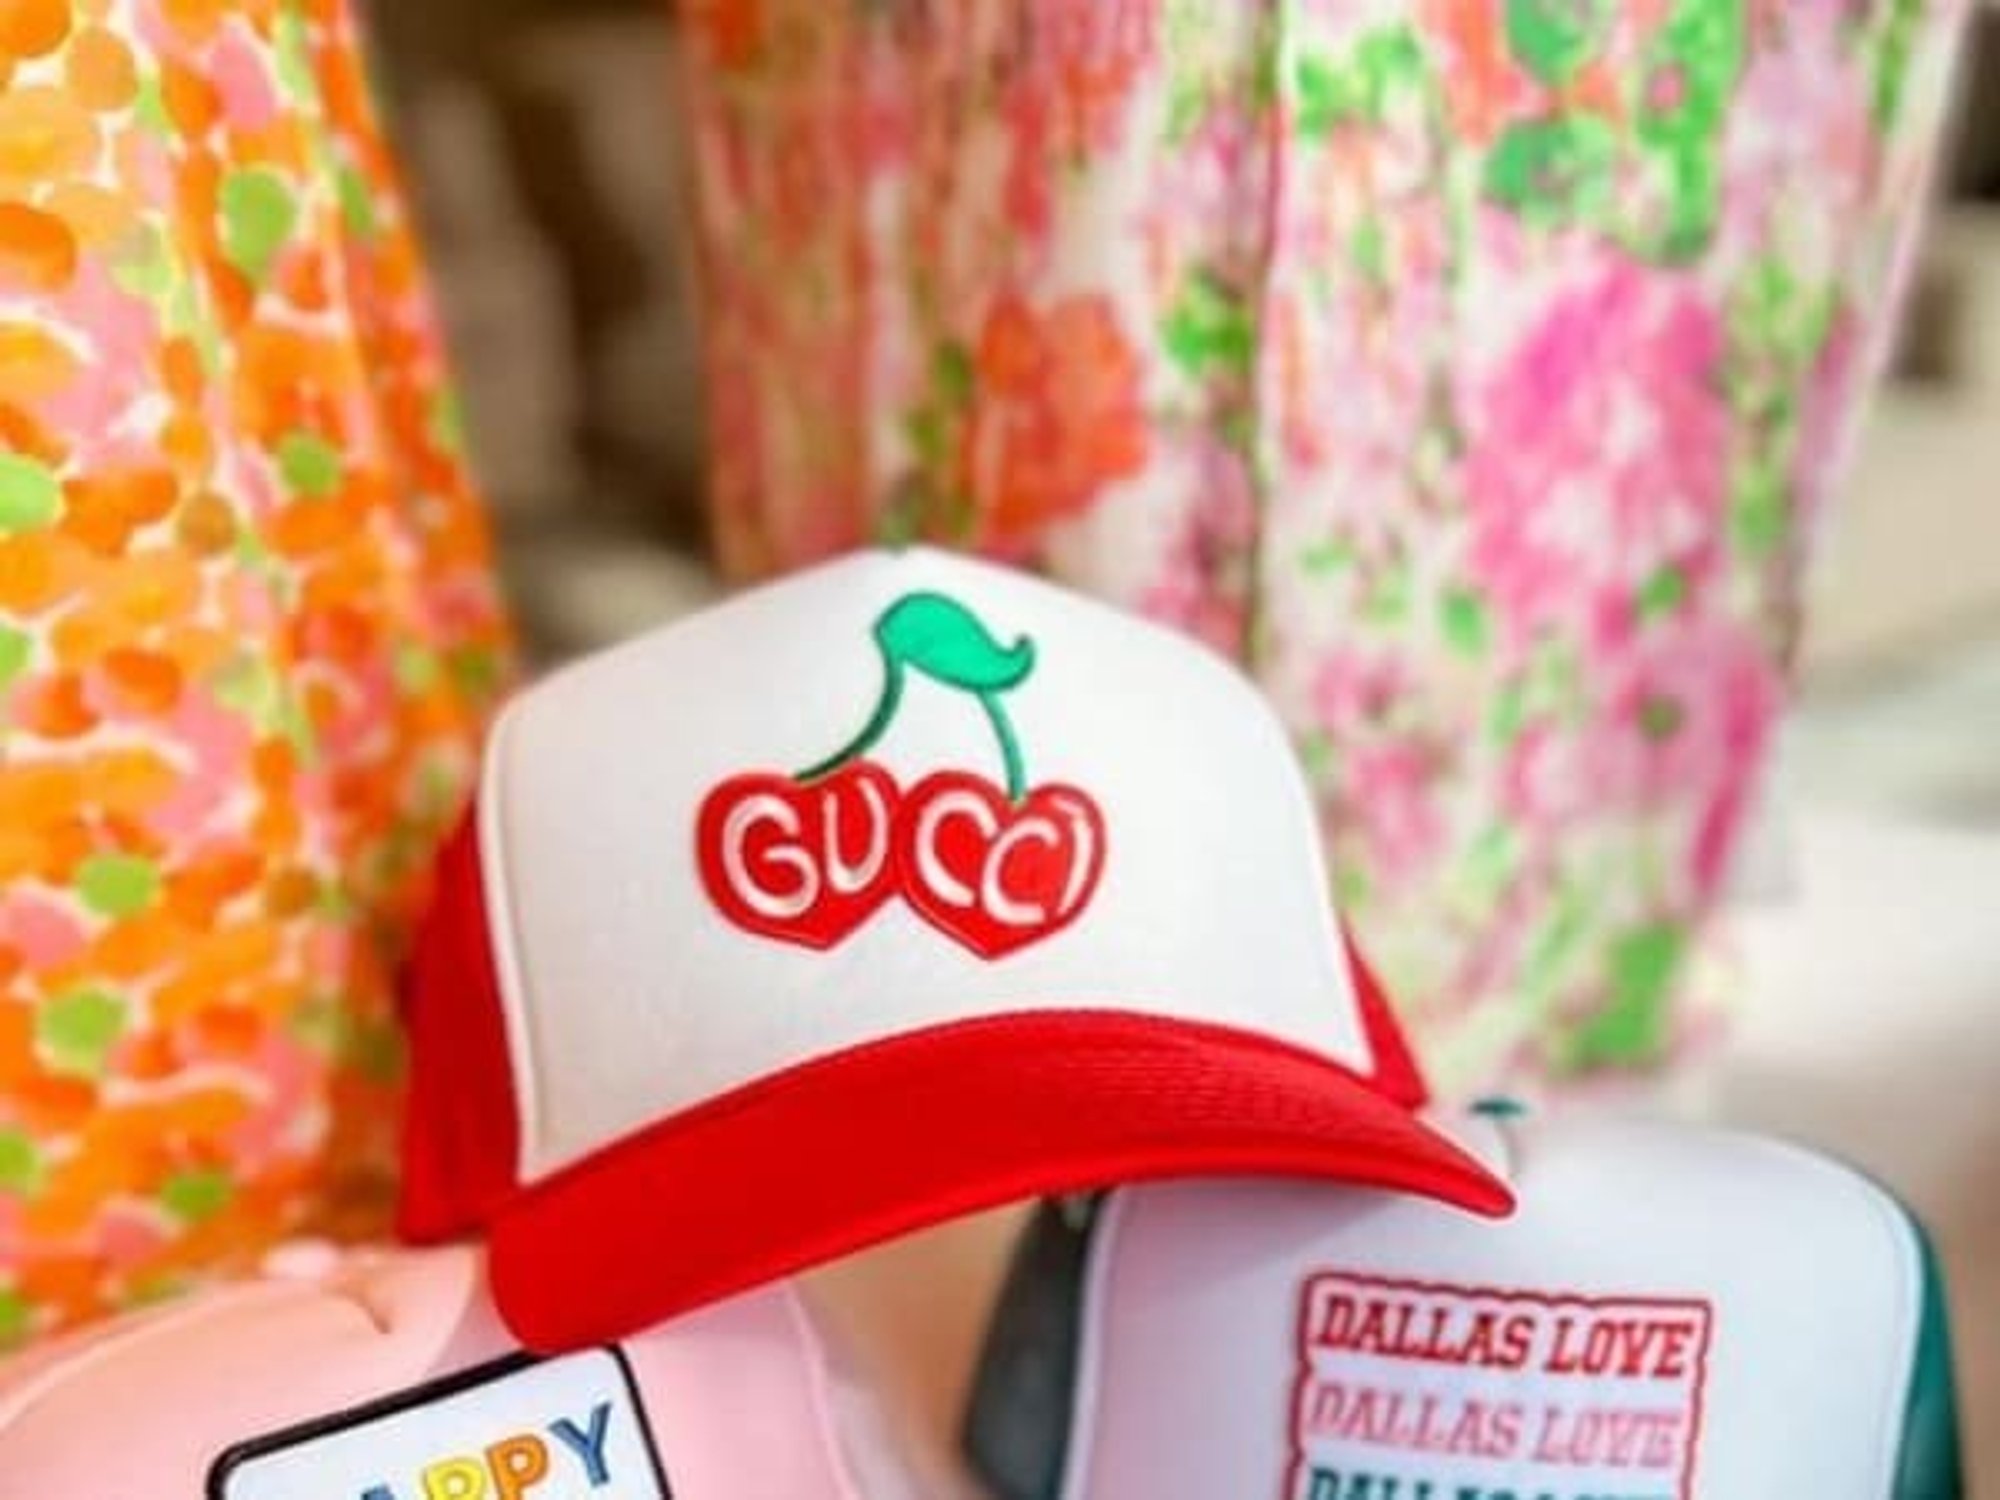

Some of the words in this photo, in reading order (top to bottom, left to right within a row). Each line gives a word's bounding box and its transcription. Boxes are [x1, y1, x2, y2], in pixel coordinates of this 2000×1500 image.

[721, 776, 1094, 926] GUCCI
[1316, 1294, 1536, 1371] DALLAS
[1546, 1316, 1694, 1379] LOVE
[361, 1402, 613, 1500] PPY
[1309, 1383, 1521, 1462] DALLAS
[1532, 1404, 1682, 1468] LOVE
